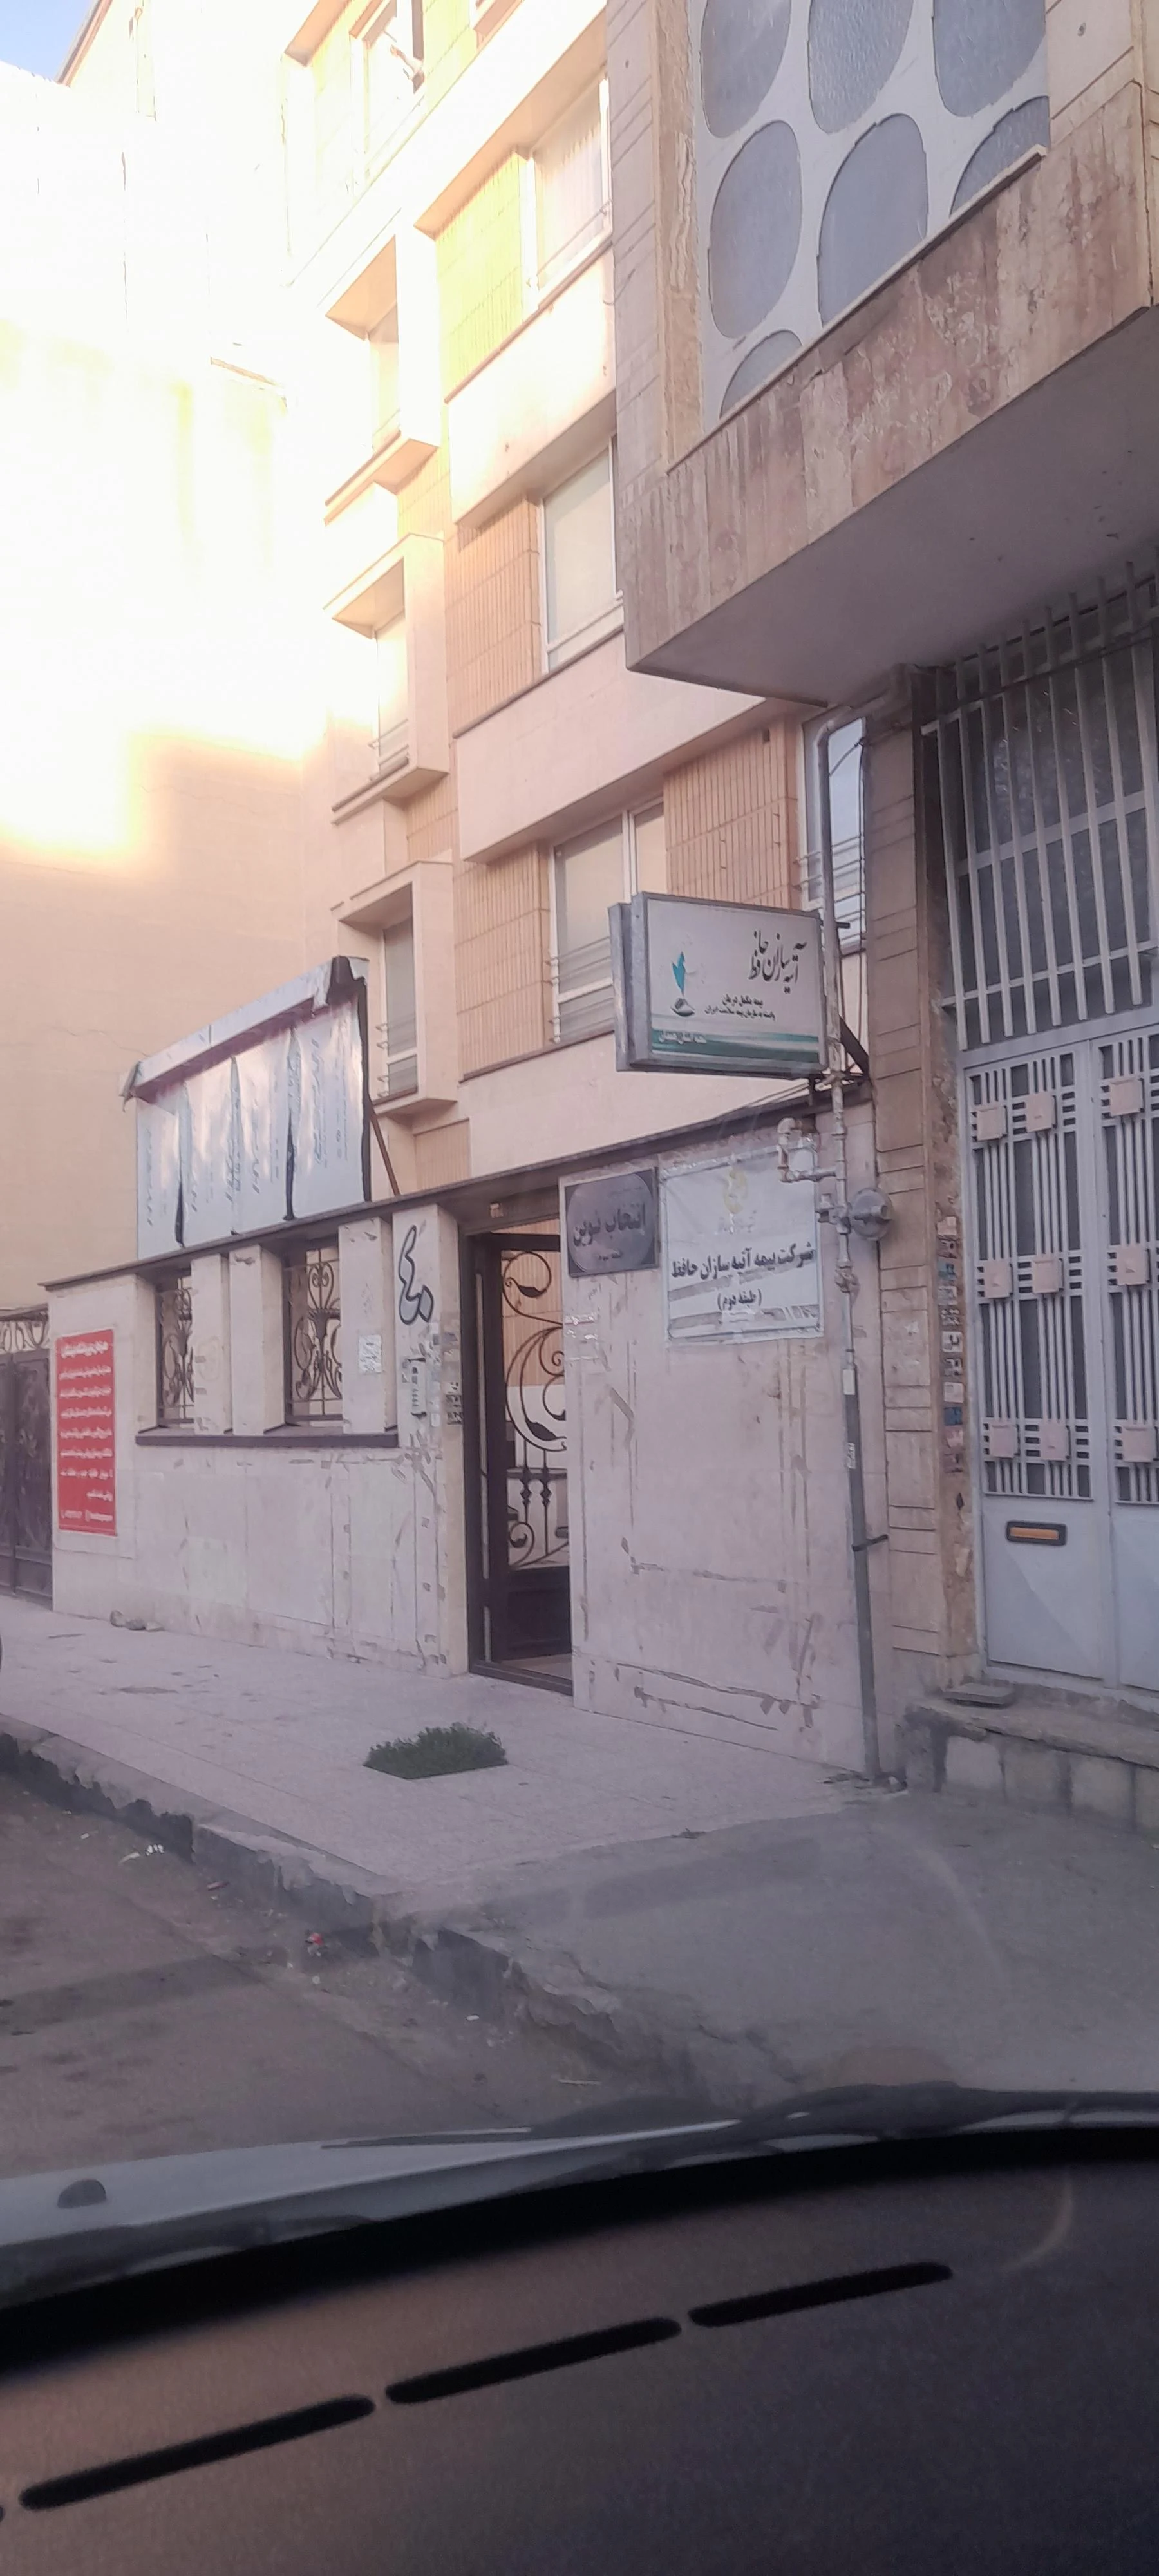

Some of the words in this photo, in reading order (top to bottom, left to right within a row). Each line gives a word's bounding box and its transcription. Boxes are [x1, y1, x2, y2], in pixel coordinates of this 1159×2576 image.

[573, 1209, 601, 1247] نوین
[605, 1202, 646, 1239] انتخاب
[671, 1257, 699, 1278] حافظ
[700, 1254, 730, 1280] سازان
[731, 1247, 753, 1275] آتیه
[754, 1251, 776, 1271] بیمه
[777, 1242, 816, 1268] شرکت
